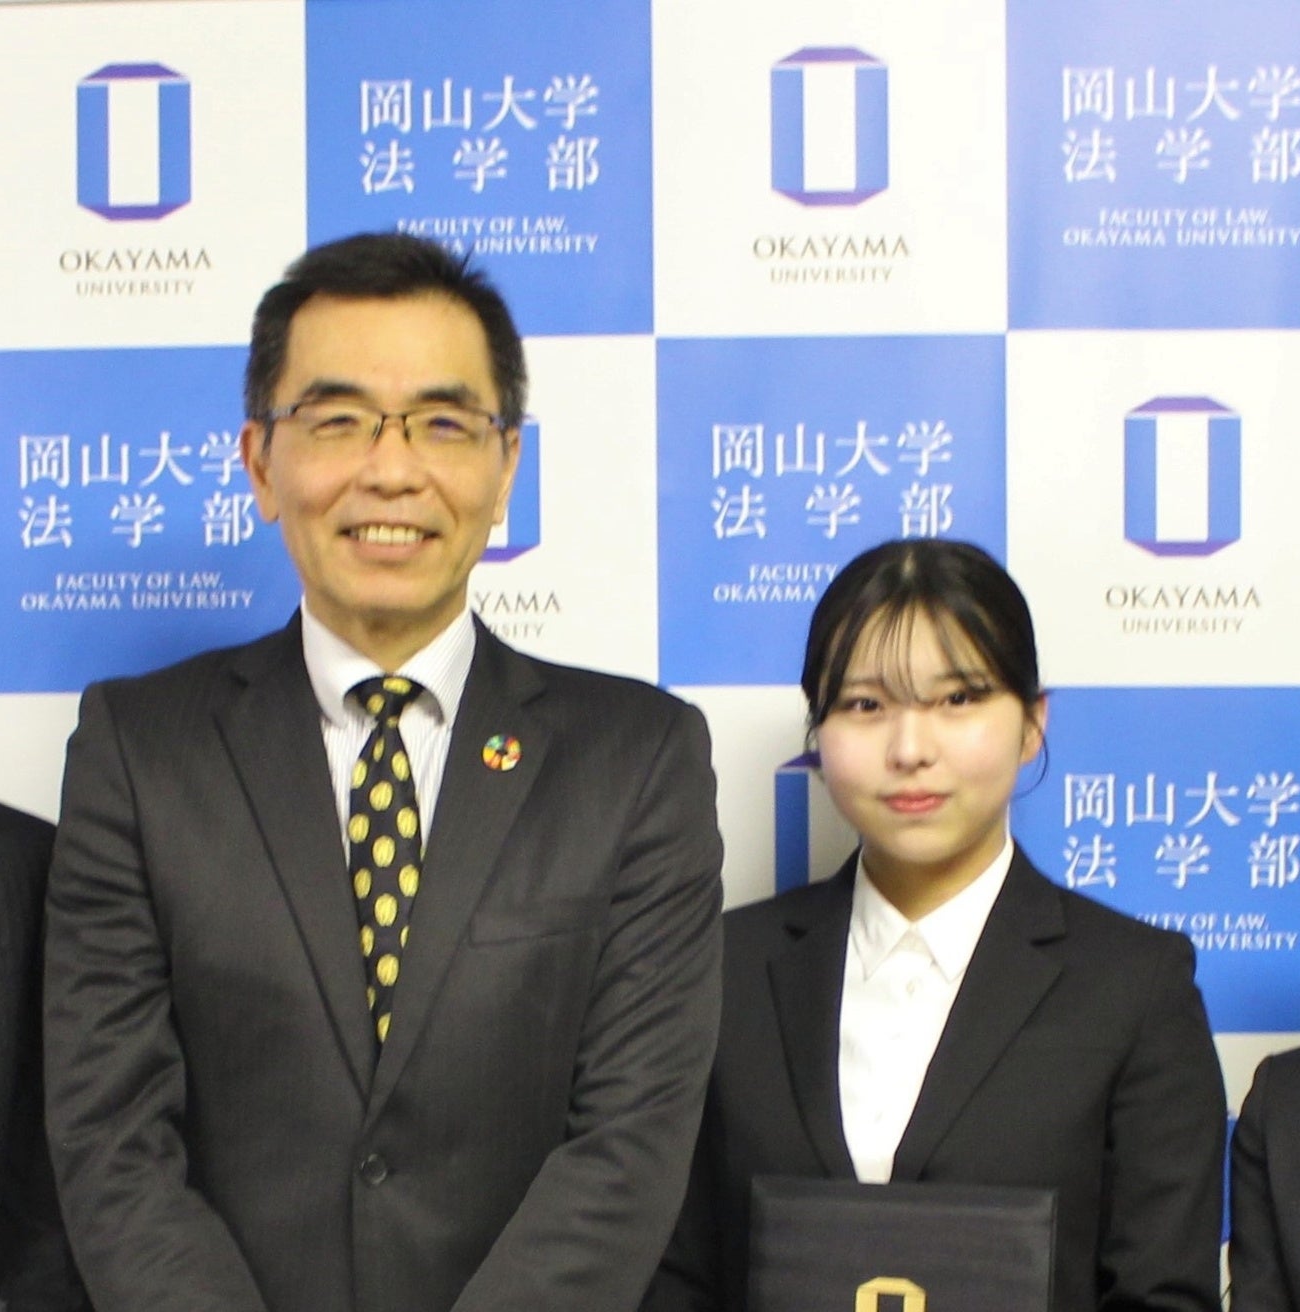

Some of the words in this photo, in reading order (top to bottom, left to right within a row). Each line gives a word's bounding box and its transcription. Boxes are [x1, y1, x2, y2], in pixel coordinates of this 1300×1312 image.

[359, 75, 599, 134] 岡山大学
[359, 134, 599, 194] 法学部
[490, 216, 515, 234] OF
[1100, 208, 1187, 227] FACULTY
[1191, 208, 1217, 226] OF
[474, 234, 598, 255] UNIVERSITY
[752, 234, 911, 260] OKAYAMA
[1063, 228, 1166, 247] OKAYAMA
[59, 248, 212, 273] OKAYAMA
[770, 266, 892, 284] UNIVERSITY
[76, 279, 195, 297] UNIVERSITY
[18, 432, 246, 489] 岡山大学
[711, 421, 954, 479] 岡山大学
[18, 493, 255, 550] 法学部
[56, 572, 142, 591] FACULTY
[147, 572, 171, 590] OF
[749, 562, 837, 582] FACULTY
[21, 593, 121, 611] OKAYAMA
[132, 590, 253, 609] UNIVERSITY
[475, 591, 561, 614] YAMA
[713, 584, 816, 603] OKAYAMA
[1104, 585, 1261, 611] OKAYAMA
[1122, 617, 1243, 635] UNIVERSITY
[1064, 771, 1300, 829] 岡山大学
[1062, 832, 1300, 890] 法学部
[1190, 912, 1218, 931] OF
[1190, 932, 1297, 950] NIVERSITY
